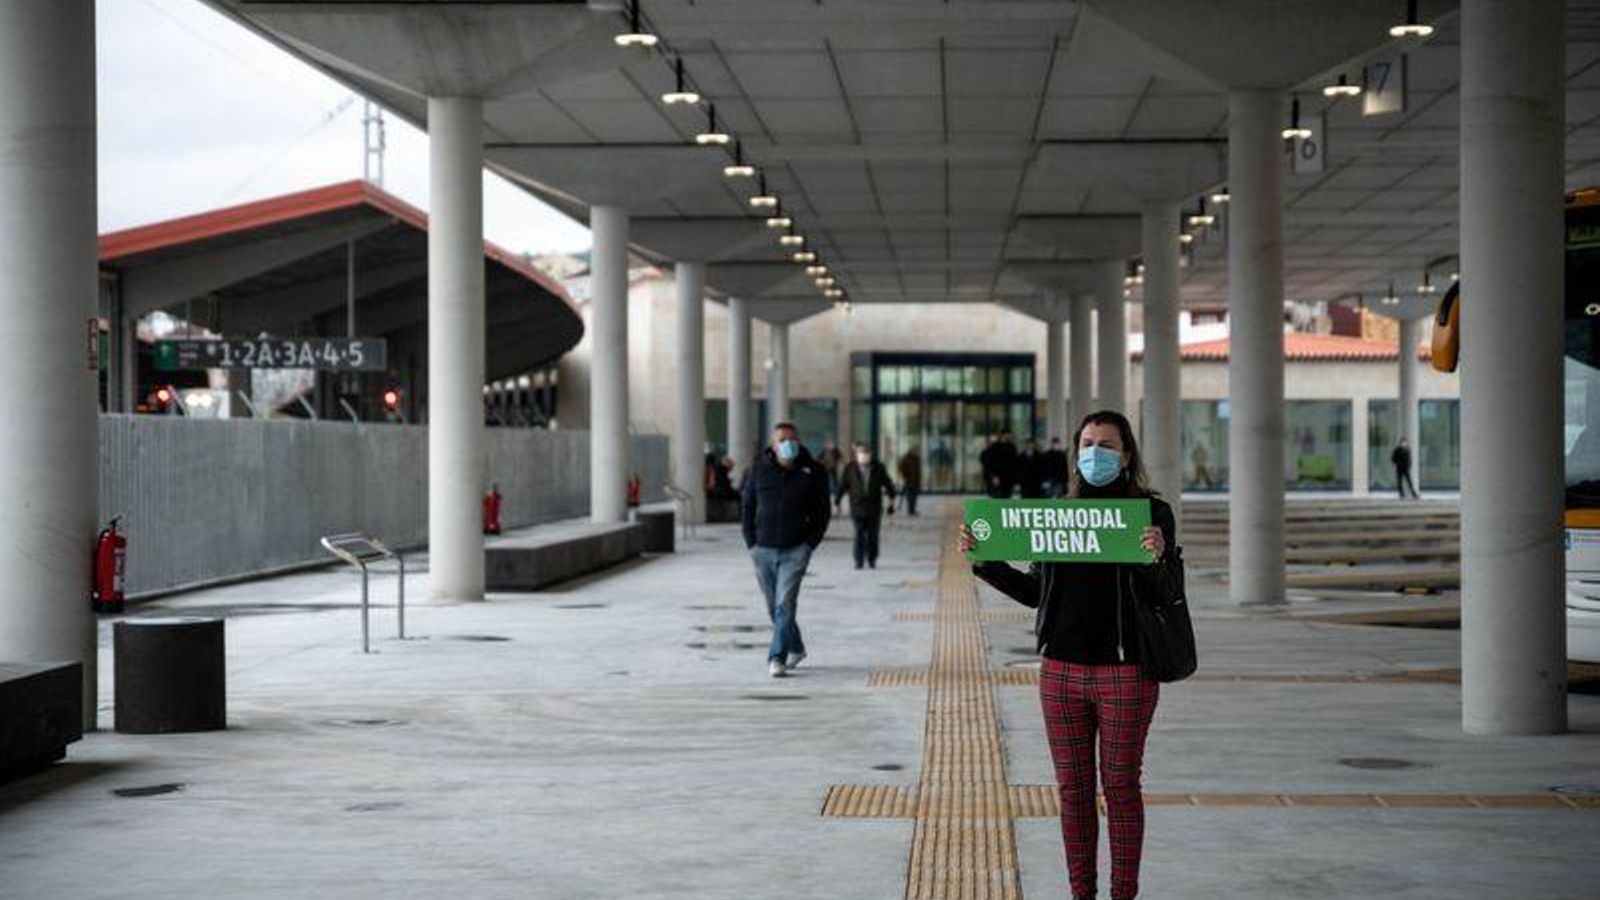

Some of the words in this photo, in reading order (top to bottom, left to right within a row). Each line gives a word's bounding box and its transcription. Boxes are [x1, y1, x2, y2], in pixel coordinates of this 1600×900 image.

[1375, 62, 1391, 95] 7
[1001, 507, 1127, 529] INTERMODAL
[1030, 529, 1102, 553] DIGNA
